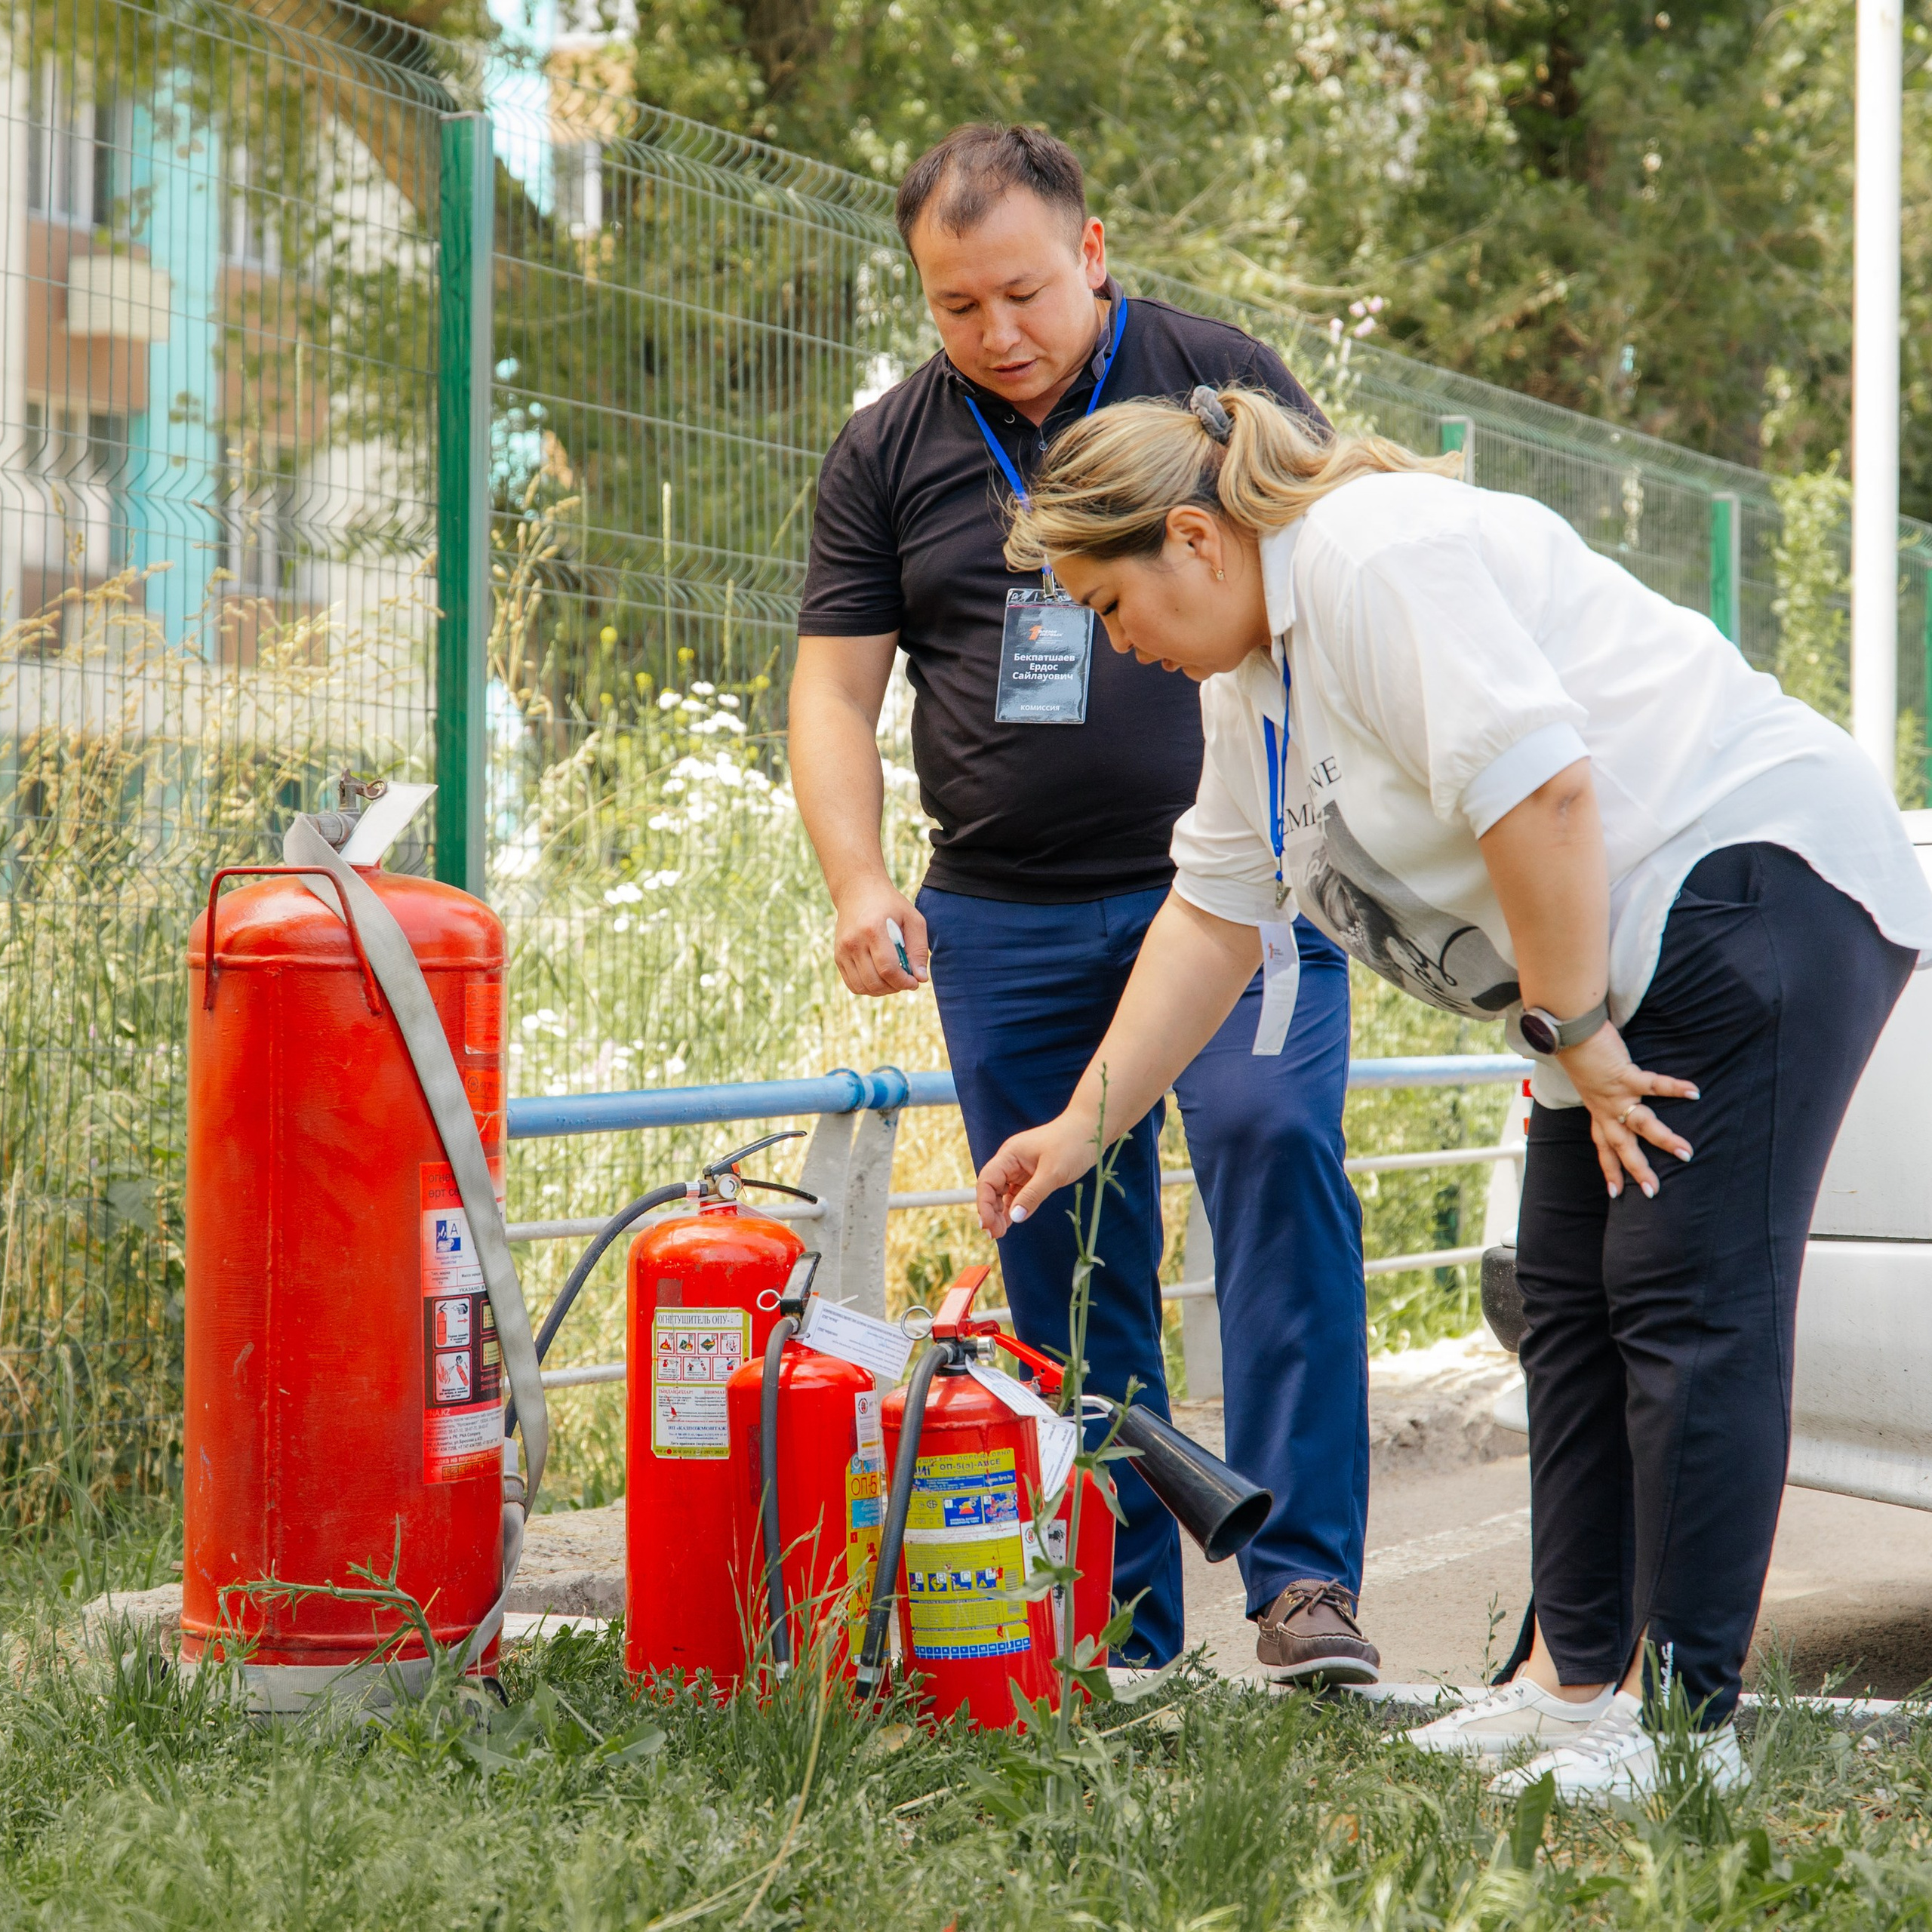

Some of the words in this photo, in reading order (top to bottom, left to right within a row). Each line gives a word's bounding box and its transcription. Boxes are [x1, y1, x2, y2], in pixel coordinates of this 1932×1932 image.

[1014, 653, 1075, 661] Бекпатшаев
[1029, 663, 1059, 672] Ердос
[1012, 671, 1073, 681] Сайлауович
[658, 1315, 711, 1324] ОГНЕТУШИТЕЛЬ
[425, 1408, 451, 1417] PNA.KZ
[851, 1475, 878, 1496] ОП-5
[916, 1573, 924, 1583] A
[962, 1571, 971, 1581] C
